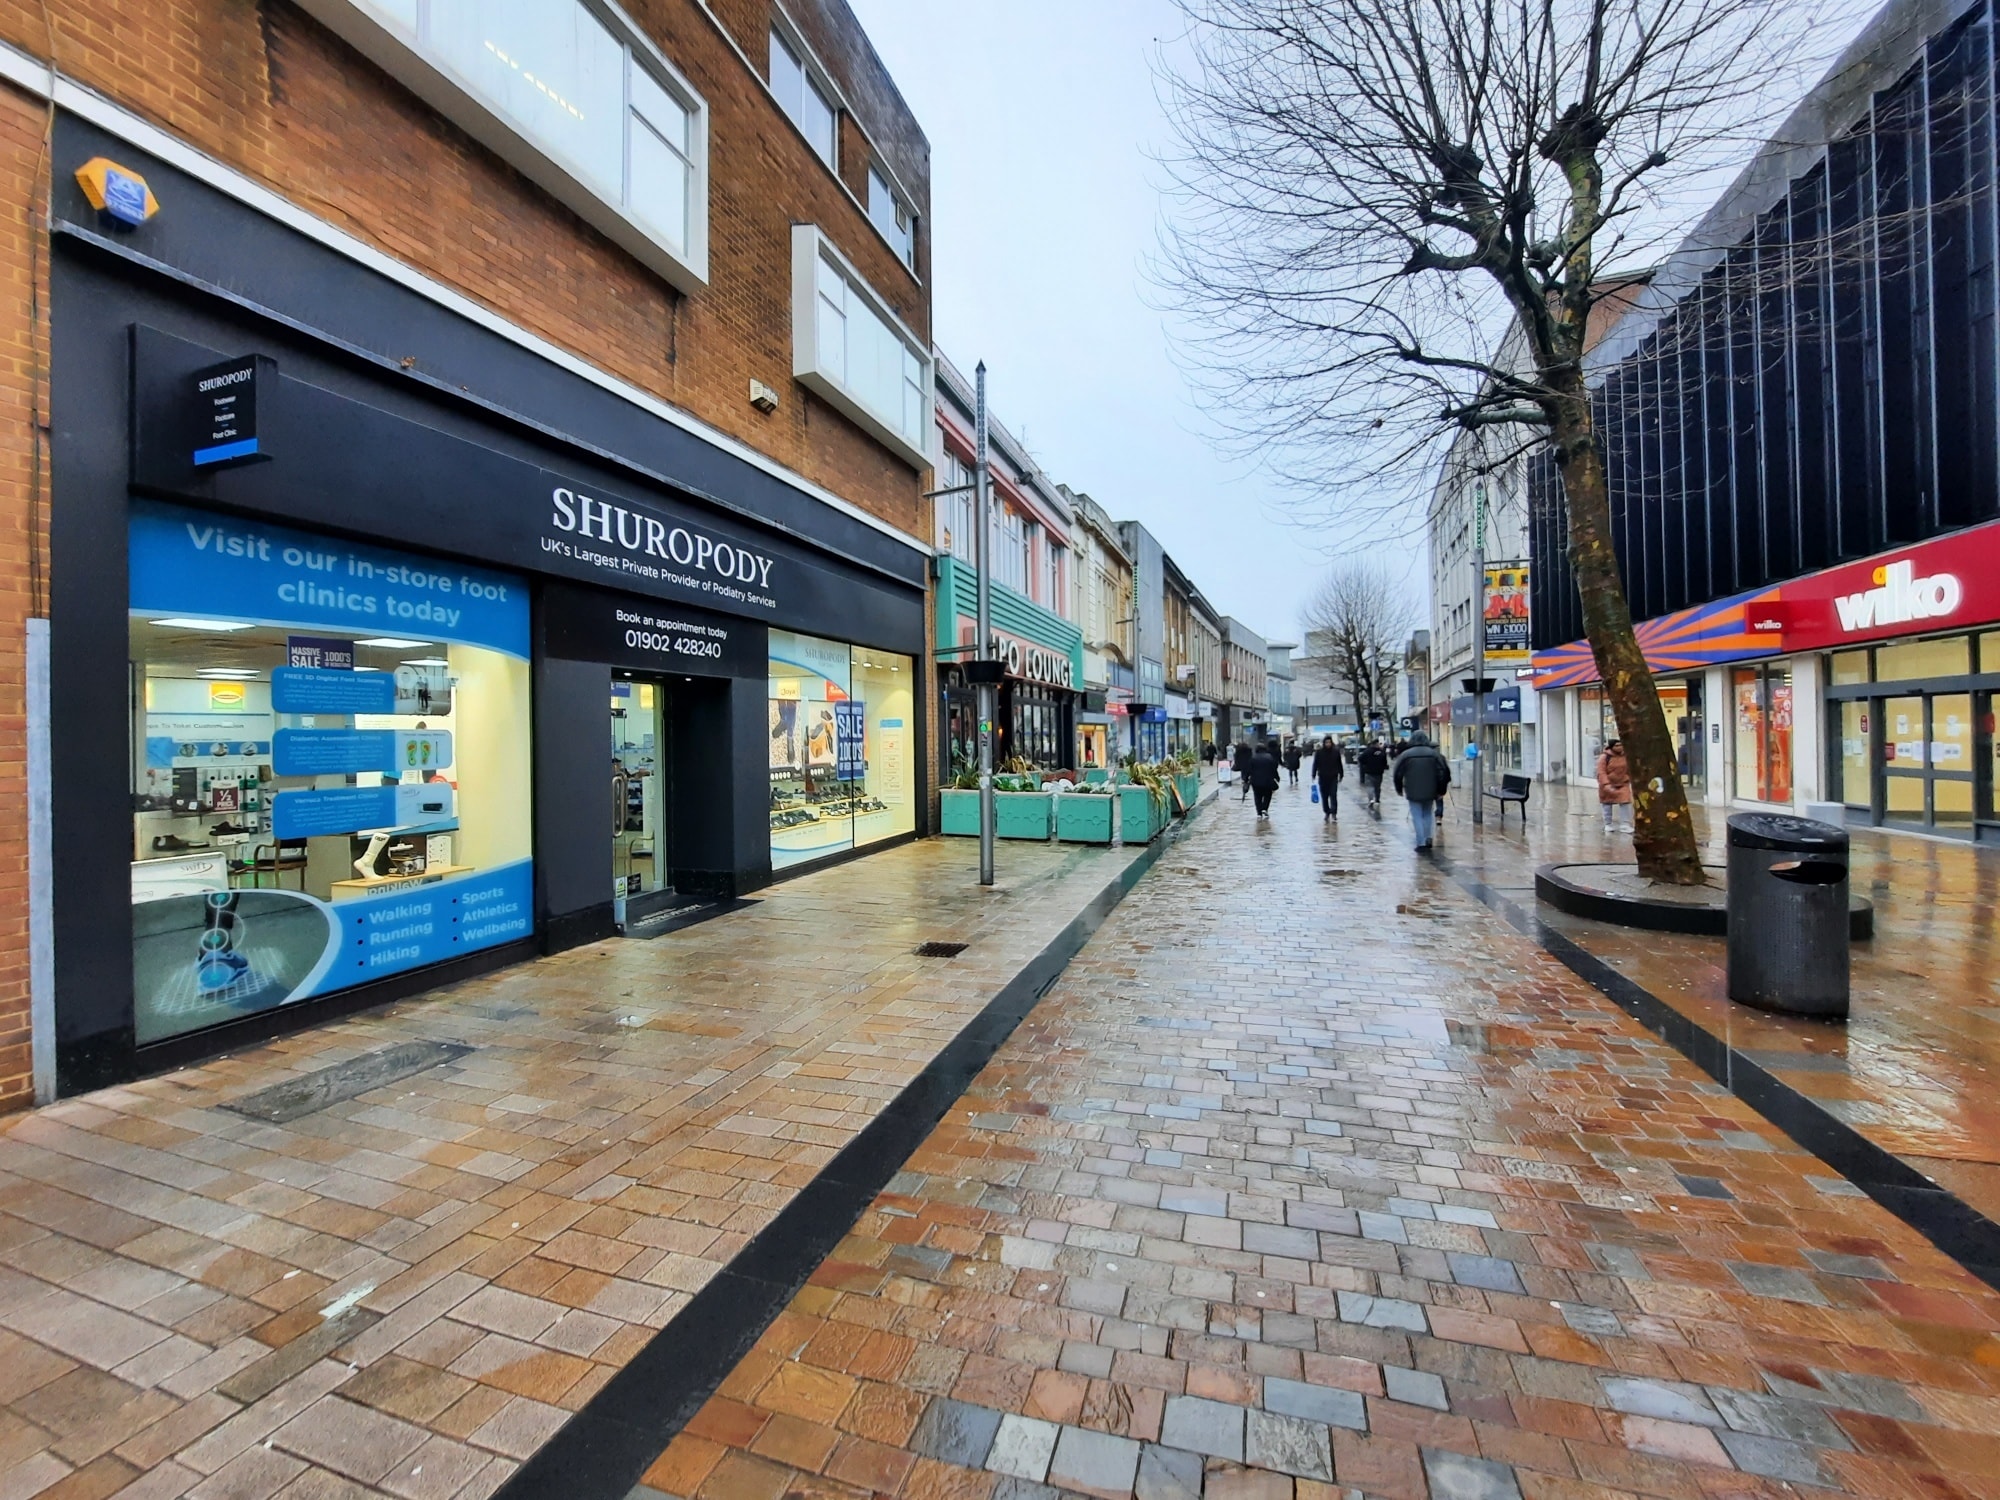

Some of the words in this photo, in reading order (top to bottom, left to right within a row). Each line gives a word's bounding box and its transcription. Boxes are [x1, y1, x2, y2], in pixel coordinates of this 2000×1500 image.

[198, 368, 252, 392] SHUROPODY
[212, 431, 224, 440] Foot
[552, 487, 774, 589] SHUROPODY
[186, 523, 271, 562] Visit
[283, 547, 338, 572] our
[348, 554, 453, 593] in-store
[460, 576, 508, 602] foot
[541, 537, 571, 557] UK's
[574, 546, 619, 568] Largest
[622, 558, 658, 579] Private
[661, 568, 700, 589] Provider
[702, 581, 711, 591] of
[713, 583, 746, 602] Podiatry
[747, 591, 776, 608] Services
[277, 580, 377, 613] clinics
[386, 595, 461, 628] today
[1834, 559, 1960, 632] wilko
[616, 609, 641, 624] Book
[643, 616, 654, 626] an
[656, 618, 706, 635] appointment
[708, 626, 727, 640] today
[1486, 624, 1501, 634] WIN
[1503, 623, 1527, 634] £1000
[1754, 620, 1782, 630] wilko
[291, 646, 321, 656] MASSIVE
[625, 629, 670, 652] 01902
[674, 637, 721, 659] 428240
[291, 655, 321, 669] SALE
[324, 651, 351, 663] 1000'S
[805, 648, 846, 664] SHUROPODY
[1026, 647, 1074, 688] LOUNGE
[780, 688, 796, 696] Joya
[838, 714, 863, 739] SALE
[461, 886, 504, 905] Sports
[369, 902, 432, 924] Walking
[462, 902, 519, 923] Athletics
[370, 921, 433, 946] Running
[463, 917, 526, 942] Wellbeing
[370, 944, 421, 967] Hiking
